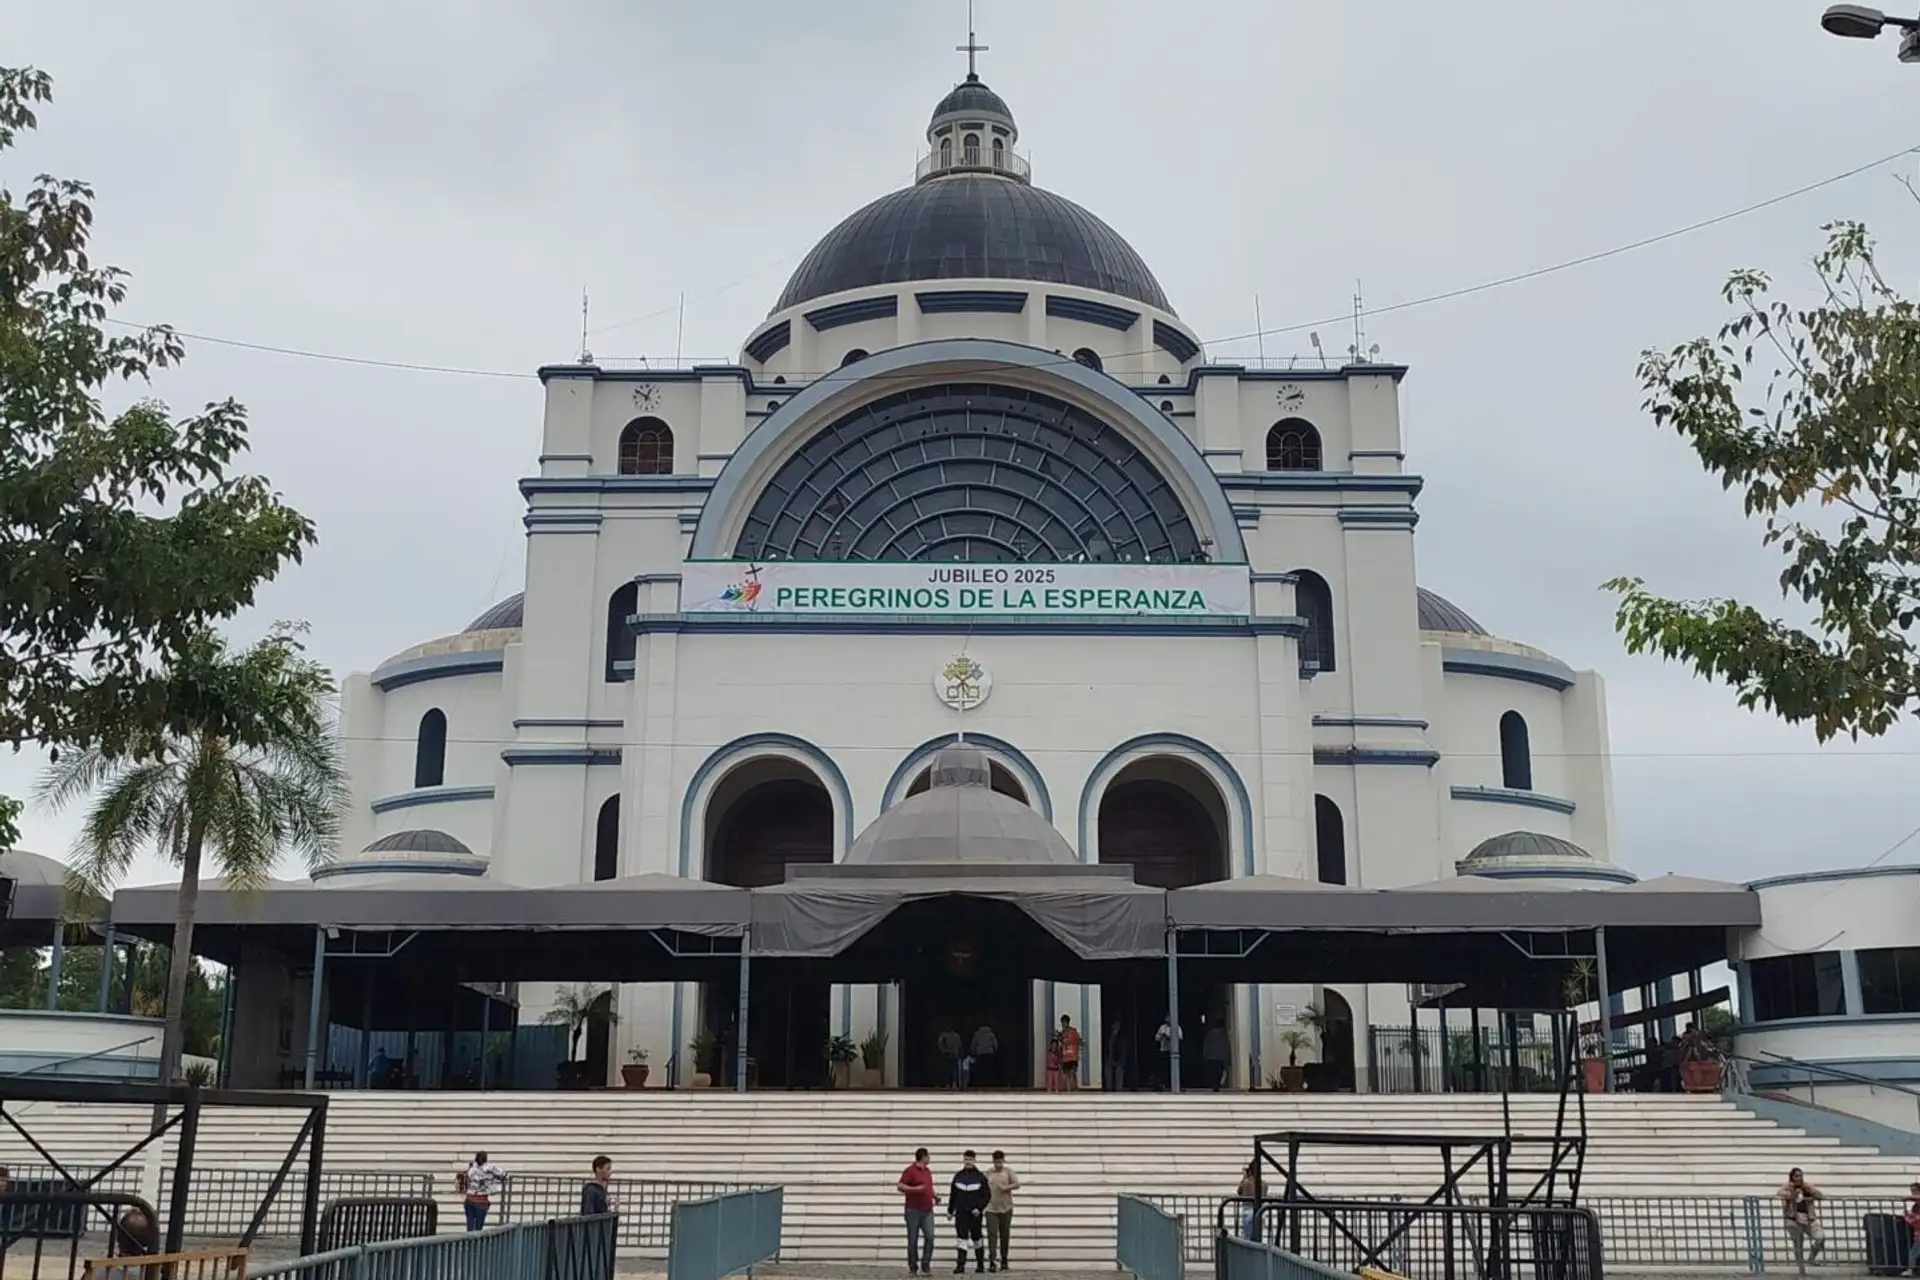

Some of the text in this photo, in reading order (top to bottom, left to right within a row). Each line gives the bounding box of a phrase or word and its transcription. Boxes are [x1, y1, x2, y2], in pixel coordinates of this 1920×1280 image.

[928, 568, 1055, 584] JUBILEO 2025
[776, 587, 1207, 610] PEREGRINOS DE LA ESPERANZA
